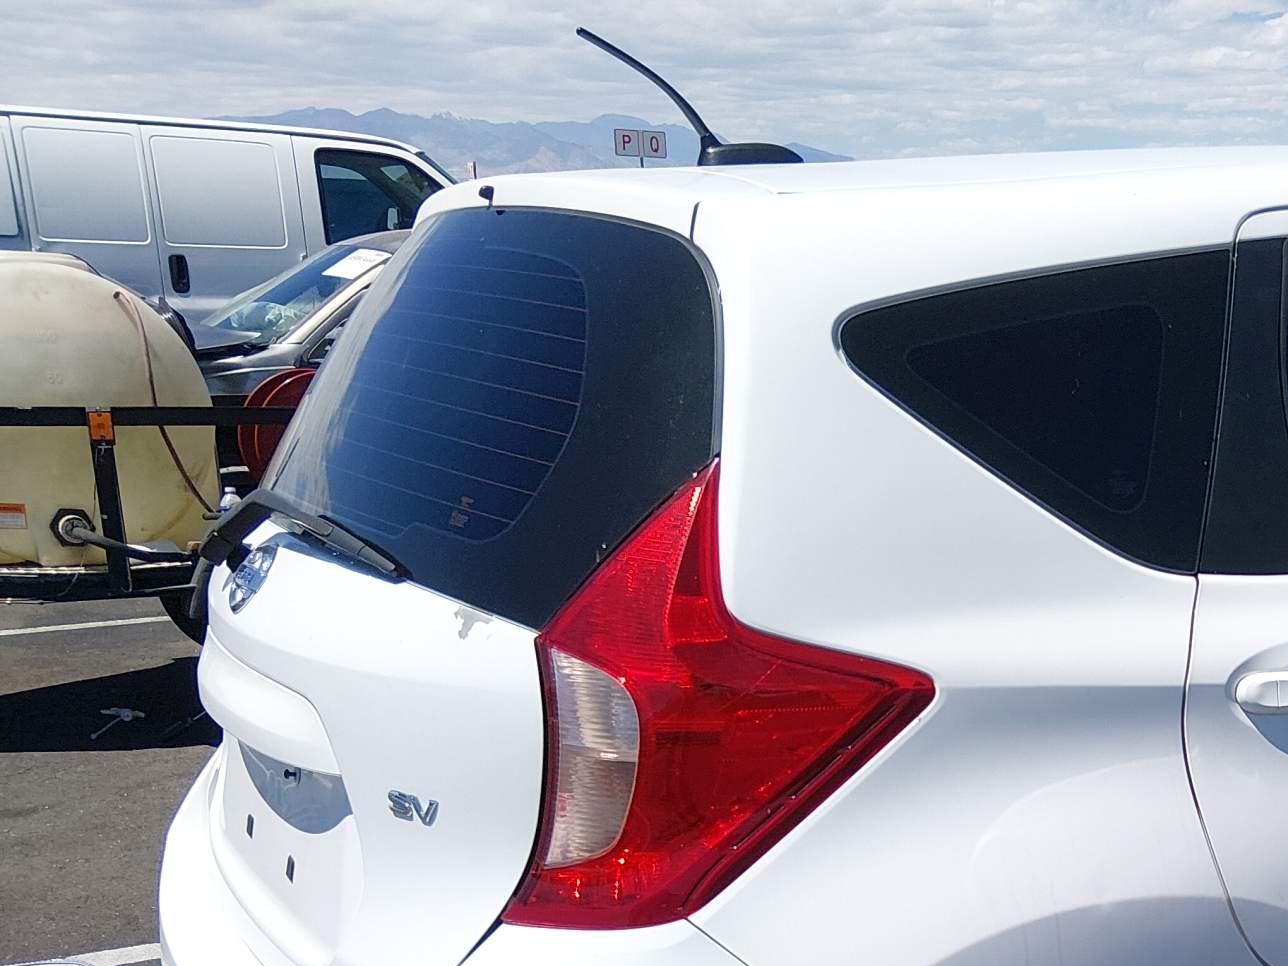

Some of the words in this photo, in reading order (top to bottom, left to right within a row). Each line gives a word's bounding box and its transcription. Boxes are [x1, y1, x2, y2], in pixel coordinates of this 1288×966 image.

[622, 134, 631, 151] P
[650, 136, 659, 153] Q
[388, 790, 439, 826] SV
